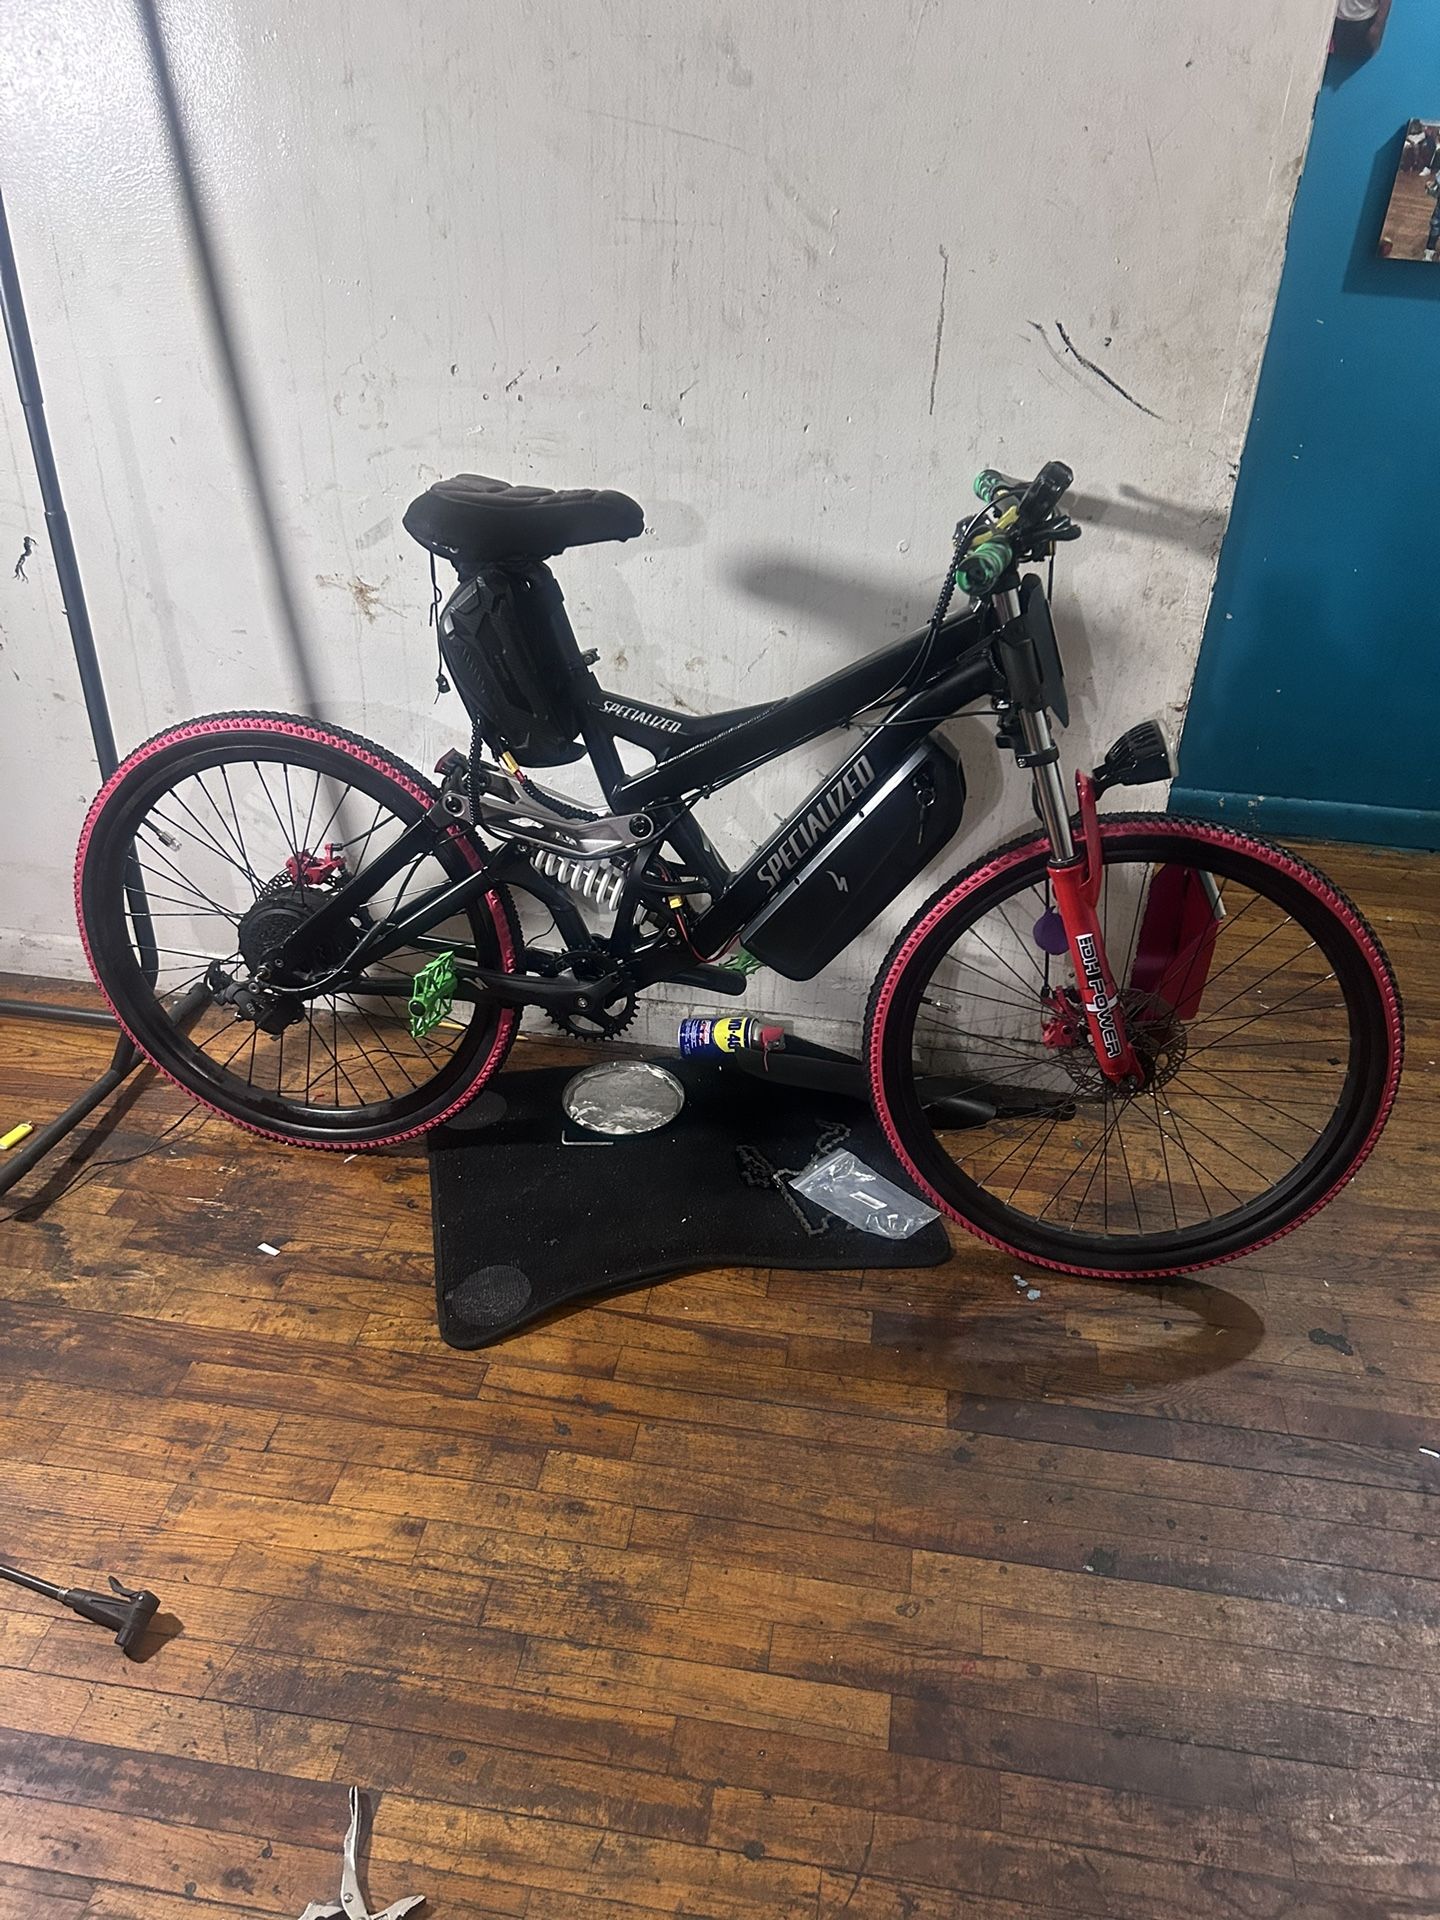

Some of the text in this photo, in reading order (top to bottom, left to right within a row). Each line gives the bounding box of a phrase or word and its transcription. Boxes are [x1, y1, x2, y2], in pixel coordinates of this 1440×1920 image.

[599, 700, 682, 733] SPECIALIZED
[756, 754, 876, 894] SPECIALIZED
[1089, 978, 1122, 1059] POWER
